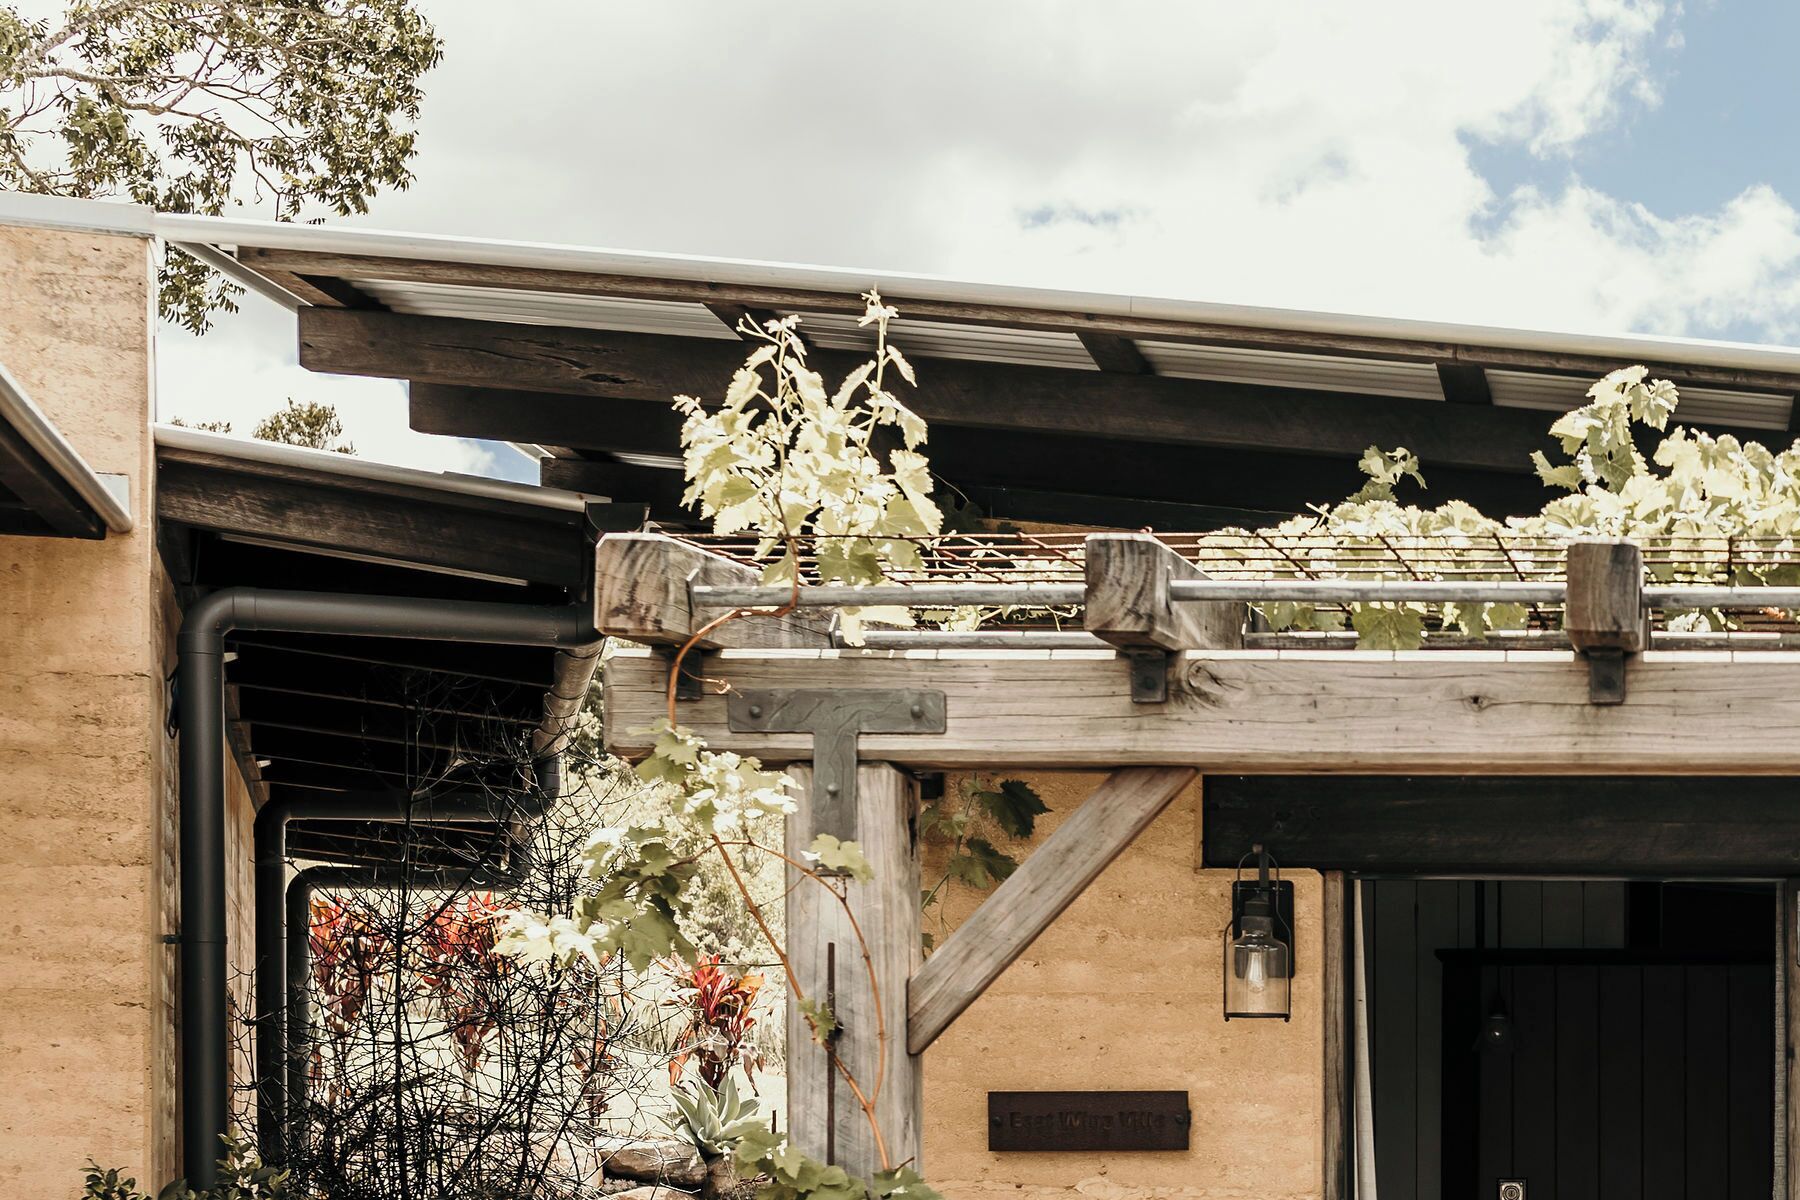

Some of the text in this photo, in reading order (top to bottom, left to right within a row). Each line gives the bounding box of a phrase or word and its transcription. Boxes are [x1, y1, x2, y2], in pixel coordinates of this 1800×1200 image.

[1009, 1111, 1165, 1130] East Wing Villa
